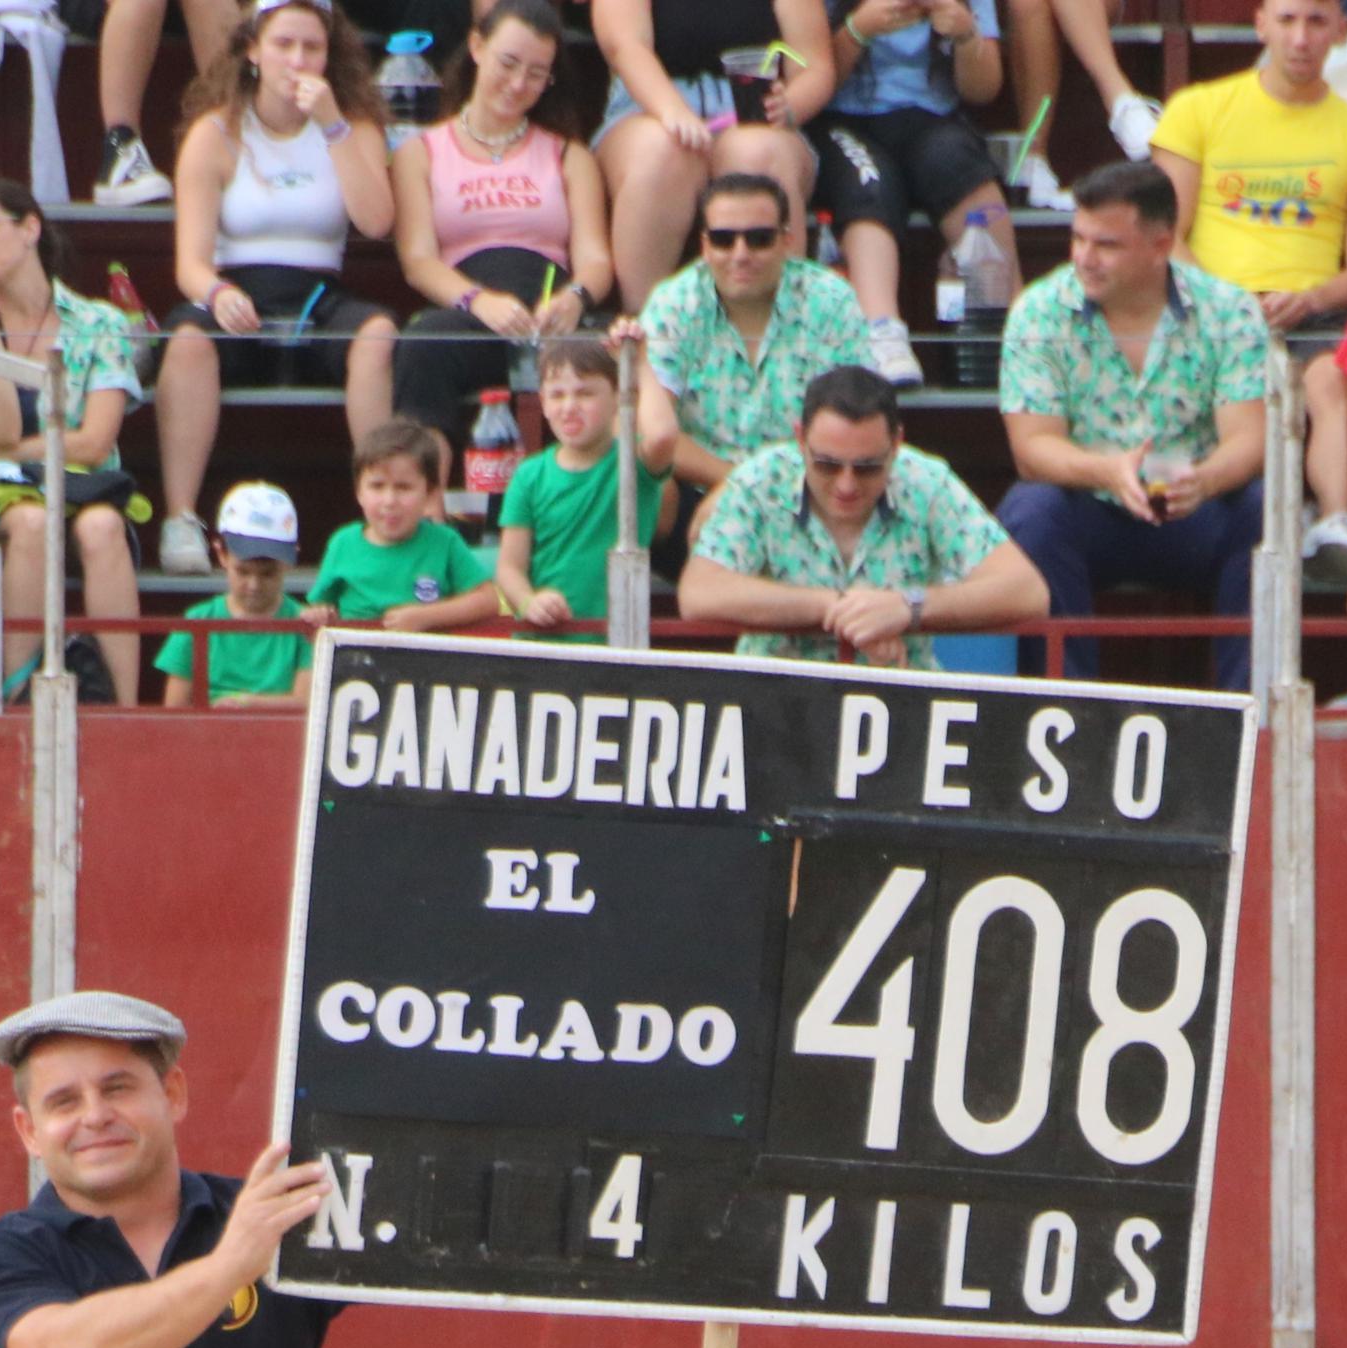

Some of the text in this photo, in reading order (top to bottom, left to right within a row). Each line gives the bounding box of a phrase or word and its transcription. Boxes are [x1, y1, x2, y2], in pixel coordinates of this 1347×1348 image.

[459, 175, 540, 196] NEVER
[461, 191, 542, 213] MIND
[326, 679, 747, 812] GANADERIA
[834, 693, 1168, 820] PESO
[483, 848, 597, 915] EL
[316, 980, 738, 1067] COLLADO
[792, 866, 1209, 1166] 408
[306, 1152, 645, 1259] N. 4
[776, 1193, 1163, 1322] KILOS
